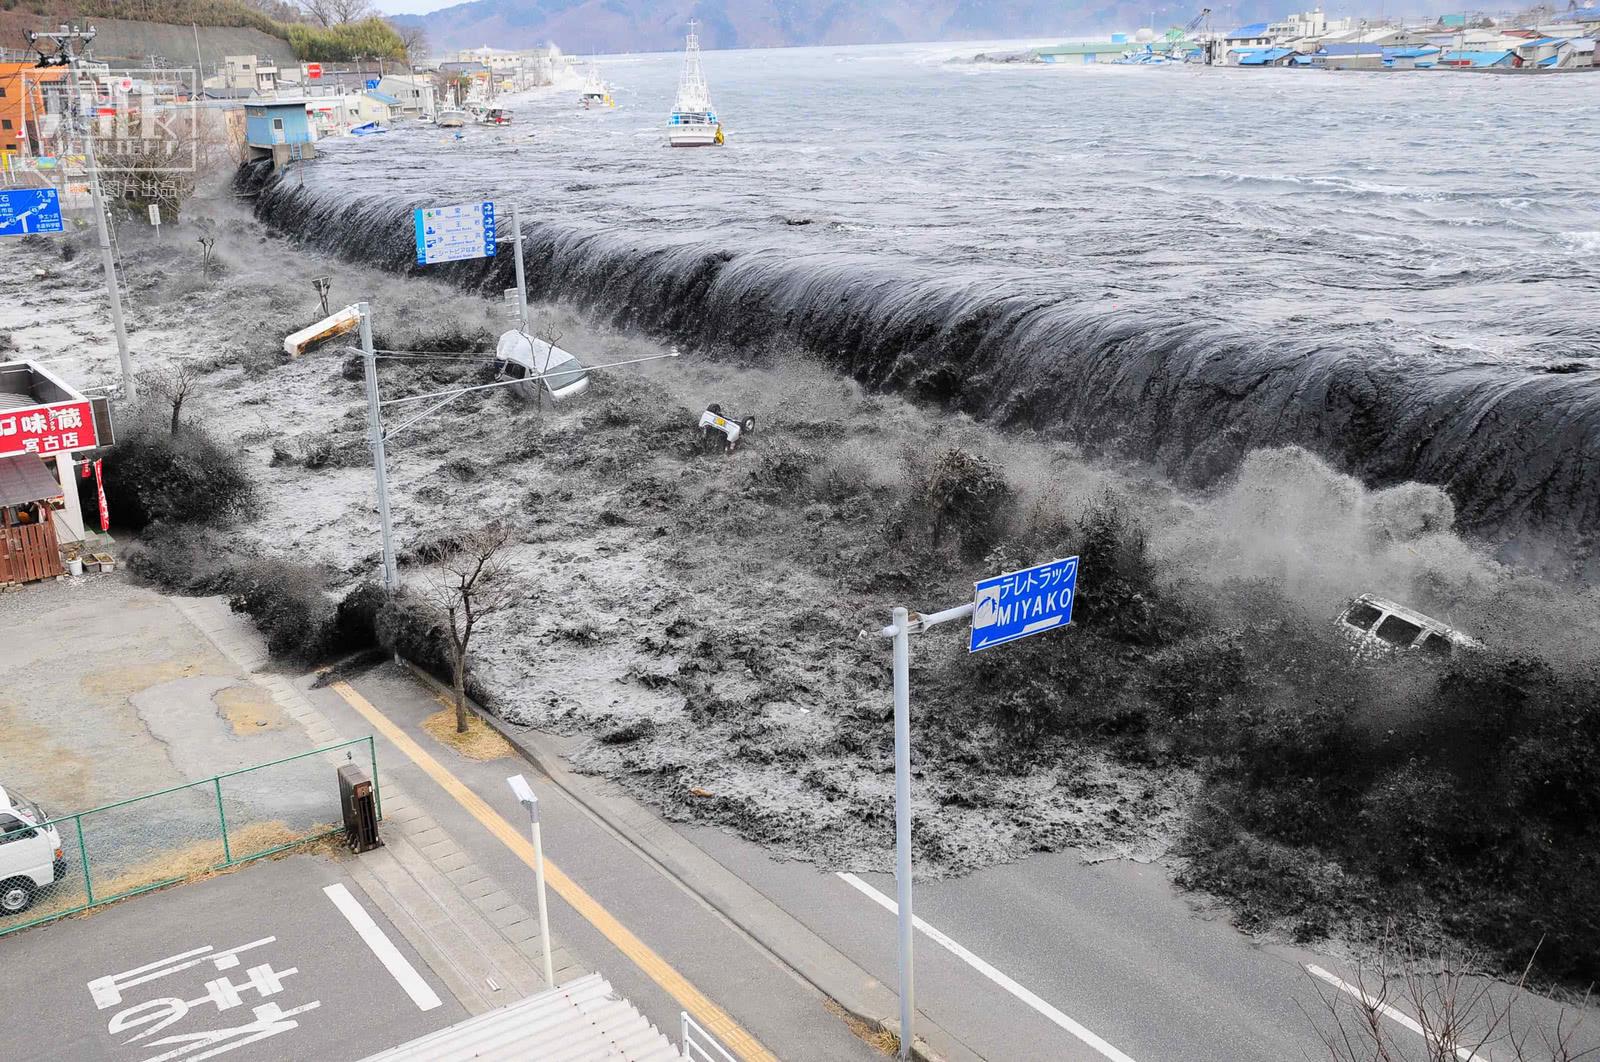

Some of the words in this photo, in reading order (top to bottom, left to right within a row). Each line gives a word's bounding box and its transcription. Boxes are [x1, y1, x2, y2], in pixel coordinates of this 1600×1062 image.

[22, 431, 79, 453] 宮古店
[1001, 561, 1076, 600] テレトラック
[997, 588, 1071, 627] MIYAKO
